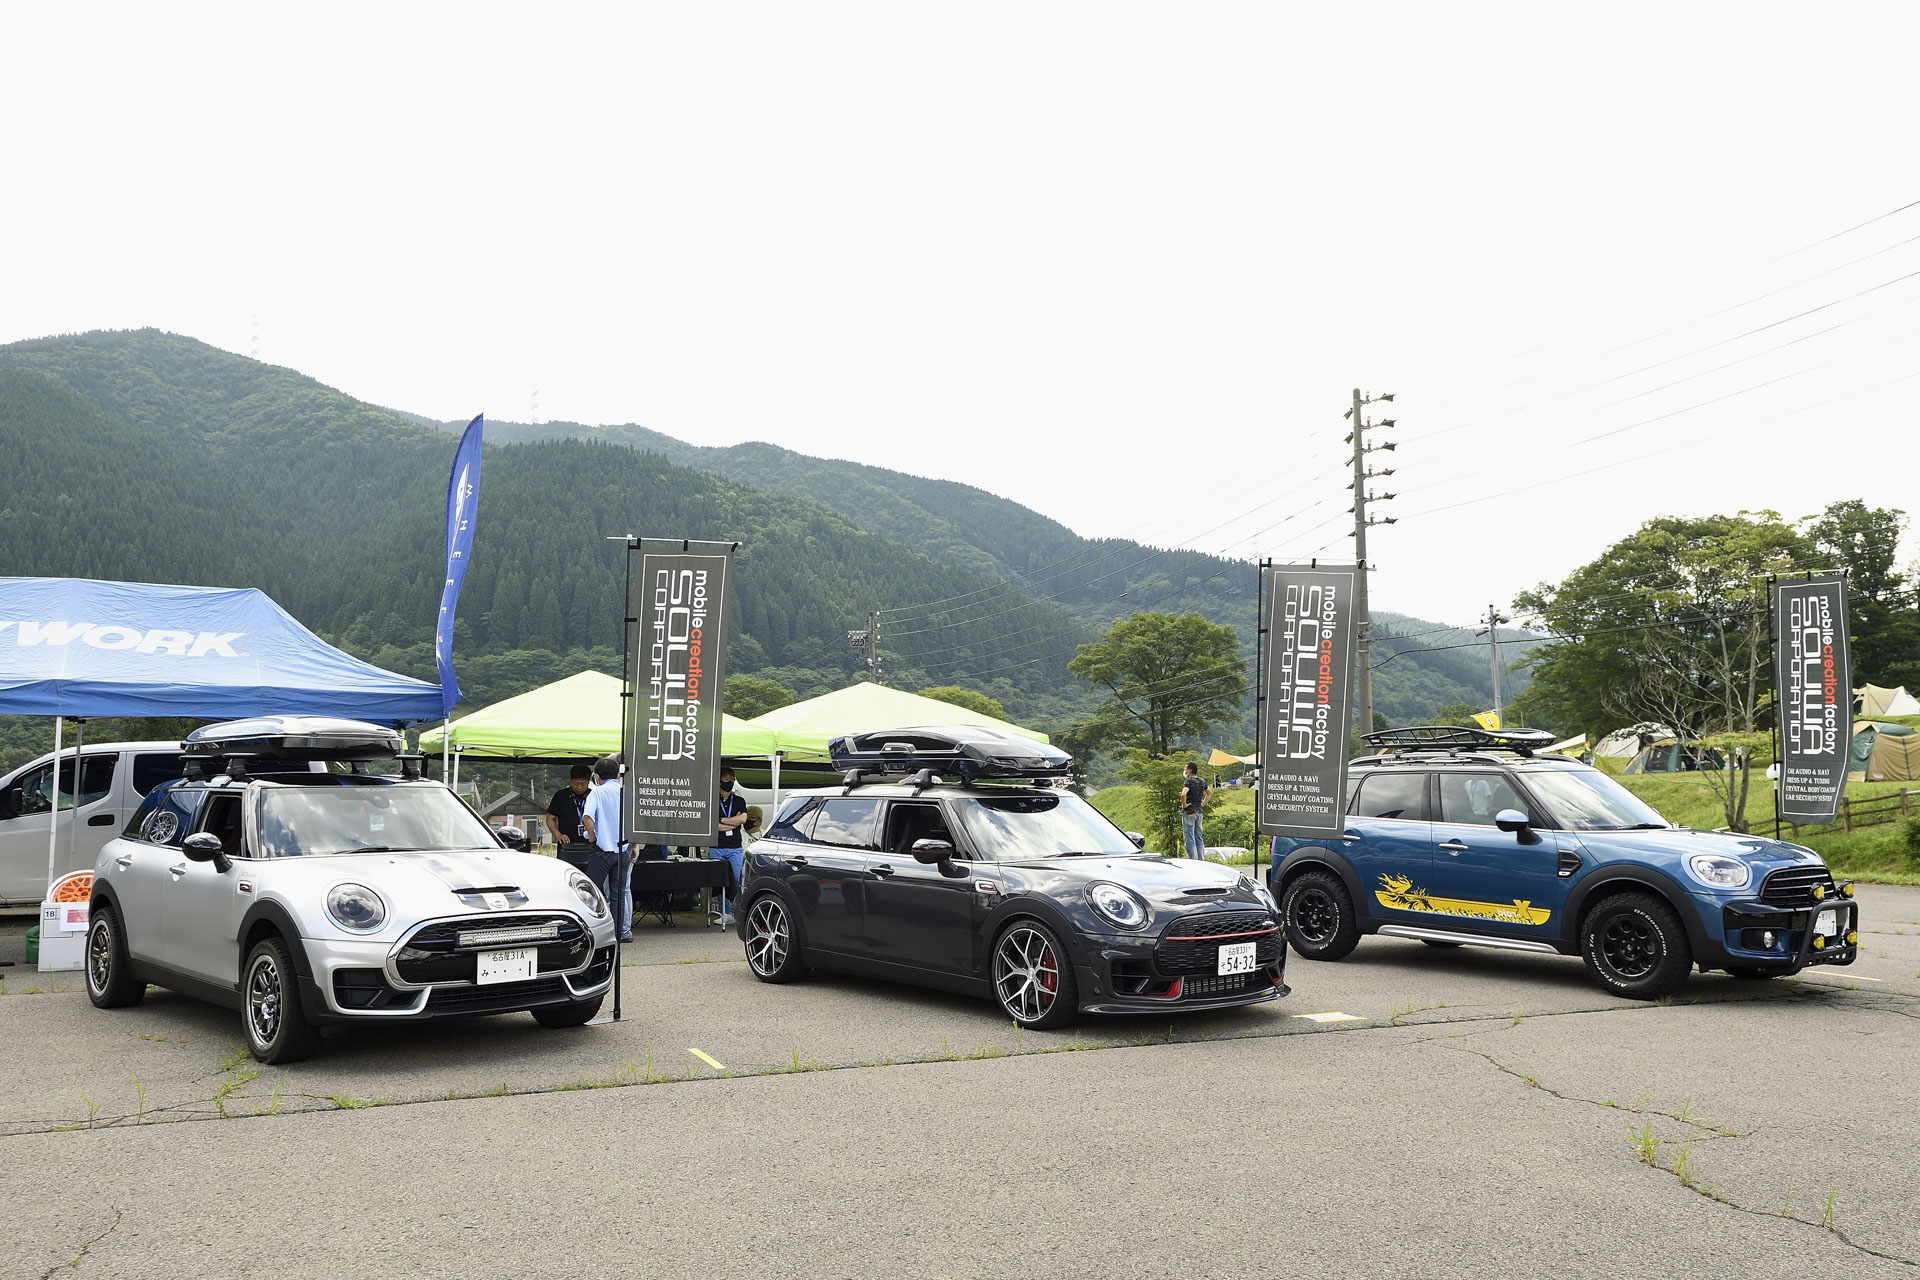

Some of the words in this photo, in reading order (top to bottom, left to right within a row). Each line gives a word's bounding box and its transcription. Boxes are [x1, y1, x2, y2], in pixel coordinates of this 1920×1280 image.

[17, 621, 247, 657] WORK
[648, 570, 669, 759] CORPORATION
[662, 569, 693, 760] SOUWA
[1277, 585, 1298, 758] CORPORATION
[1290, 585, 1322, 759] SOUWA
[1791, 598, 1800, 754] CORPORATION
[1803, 596, 1823, 755] SOUWA
[639, 798, 664, 806] CRYSTAL
[666, 799, 680, 807] BODY
[672, 789, 692, 797] TUNING
[676, 778, 690, 786] NAVI
[678, 810, 701, 818] SYSTEM
[1305, 805, 1328, 813] SYSTEM
